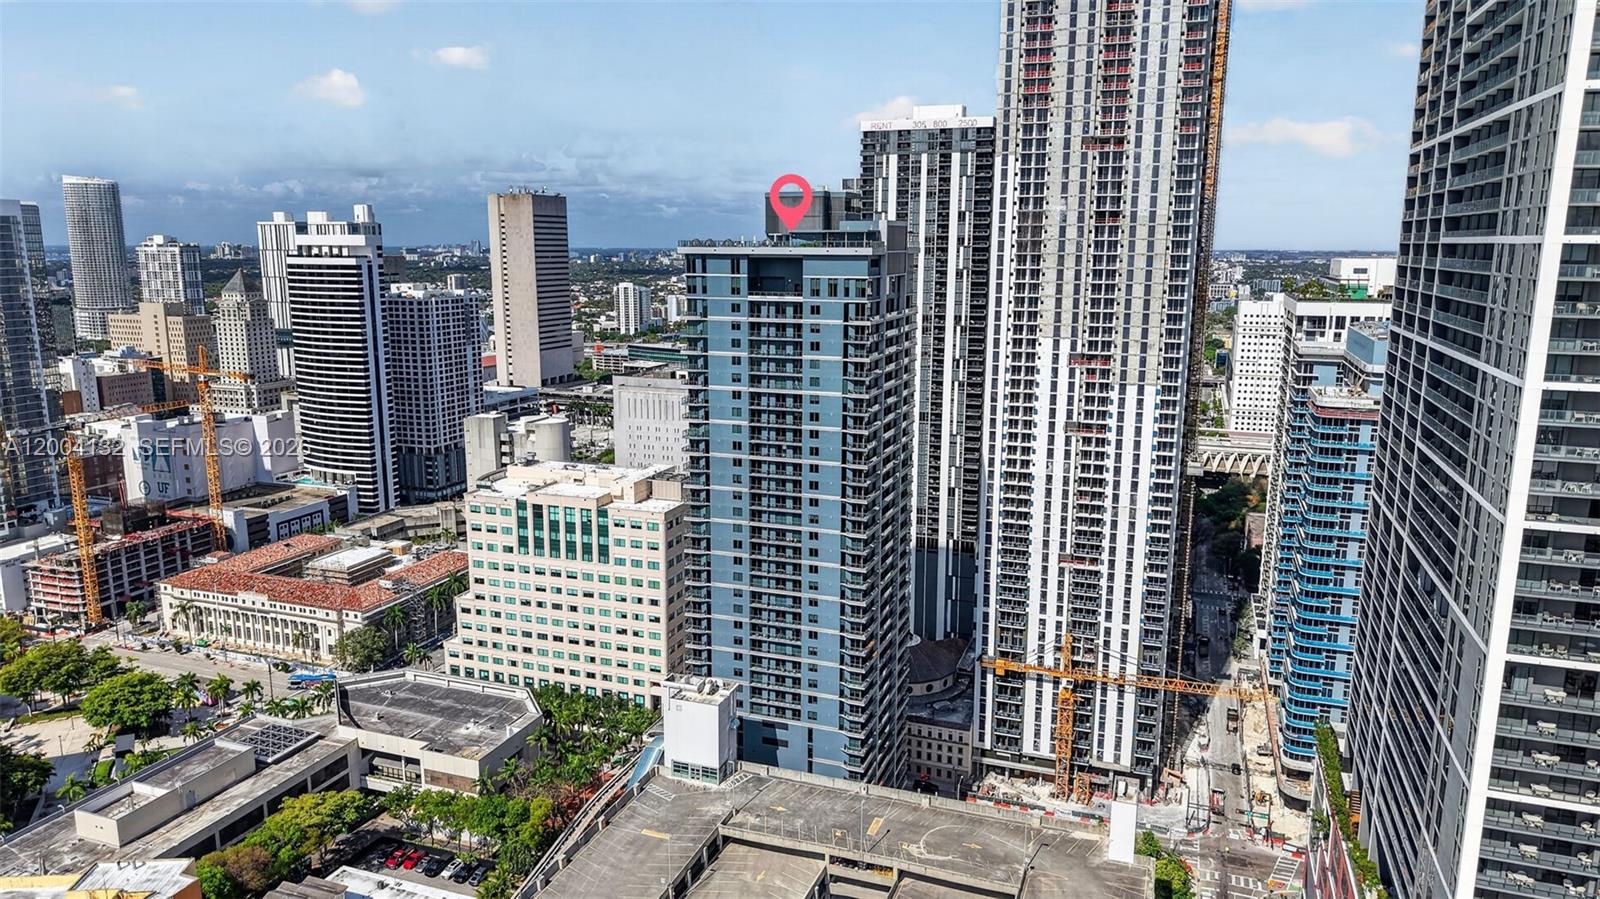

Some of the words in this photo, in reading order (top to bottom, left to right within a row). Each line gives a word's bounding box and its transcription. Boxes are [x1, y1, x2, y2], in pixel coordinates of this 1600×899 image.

[871, 122, 892, 130] RENT
[912, 121, 926, 129] 305
[933, 120, 947, 128] 800
[958, 119, 976, 127] 2500
[157, 482, 170, 494] UF
